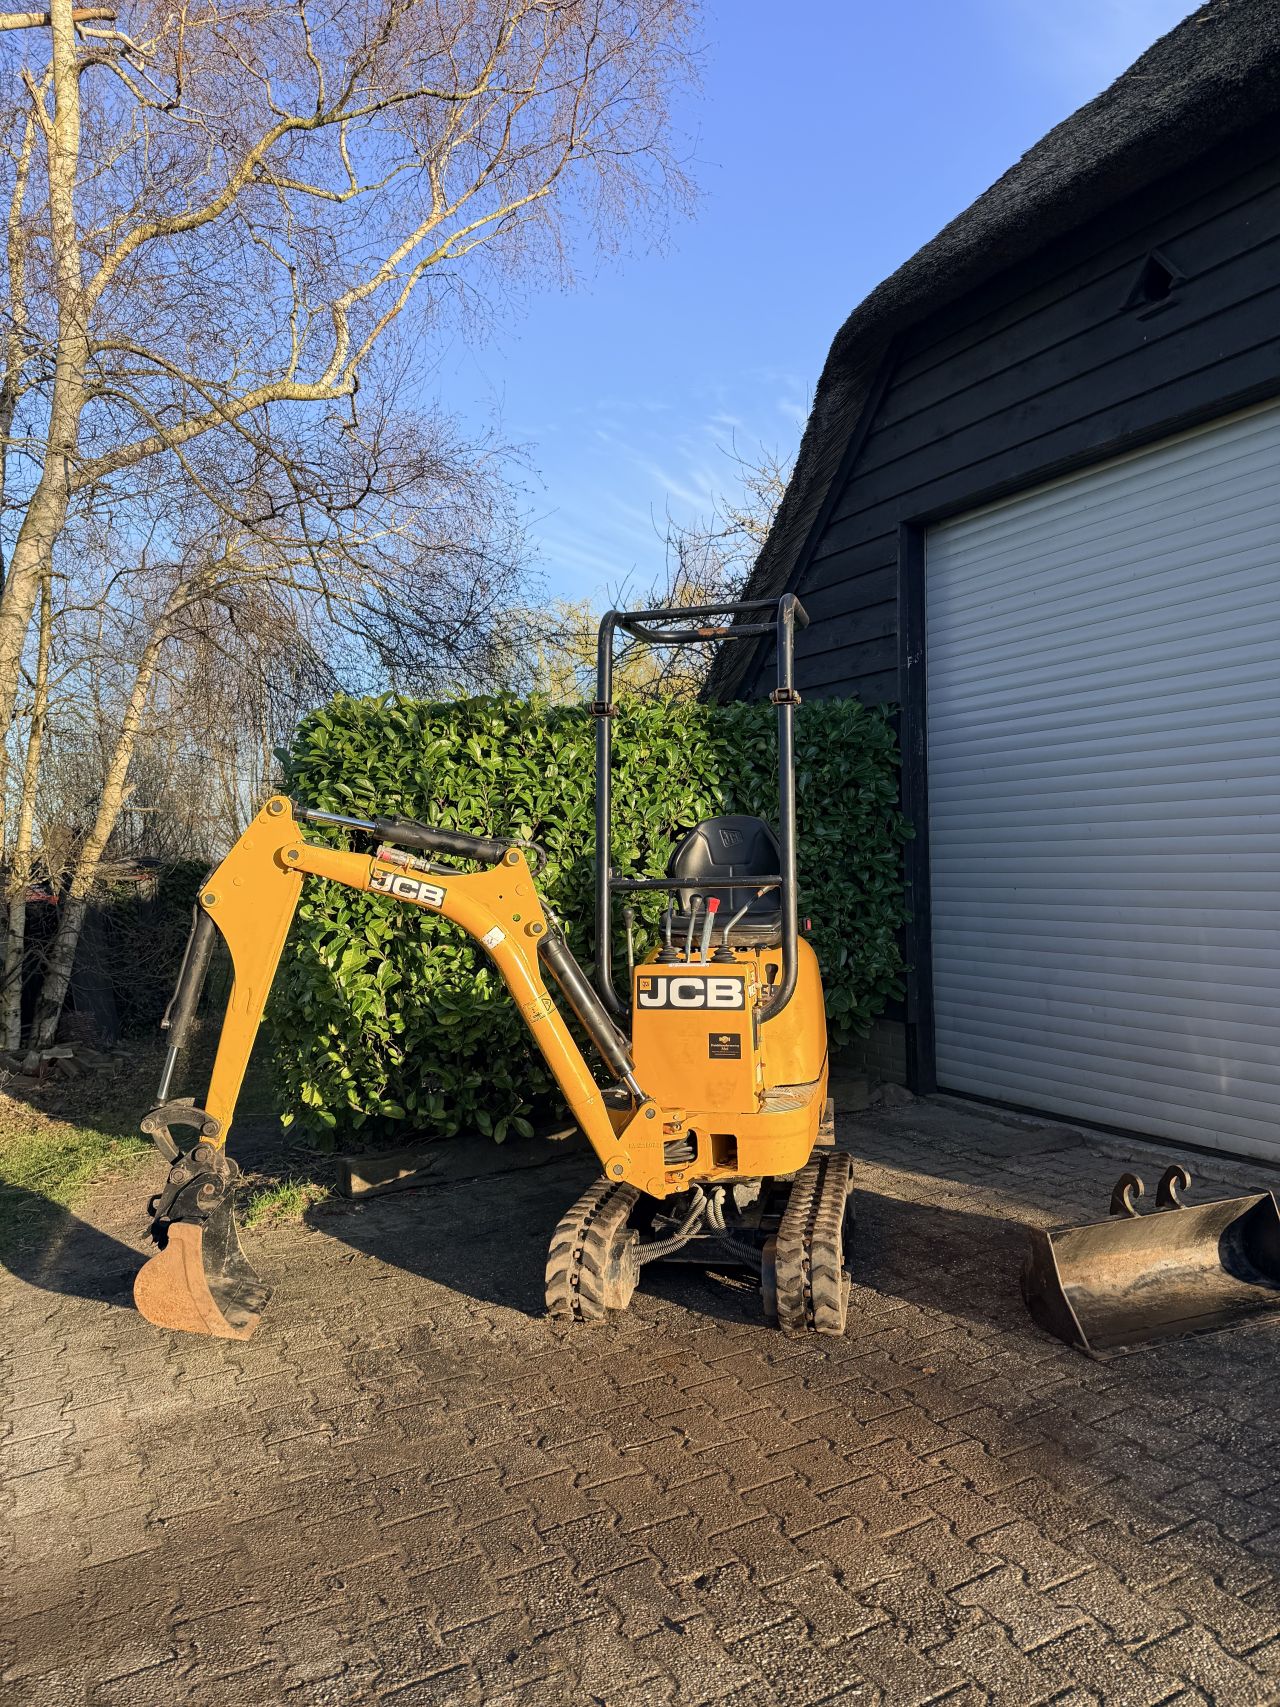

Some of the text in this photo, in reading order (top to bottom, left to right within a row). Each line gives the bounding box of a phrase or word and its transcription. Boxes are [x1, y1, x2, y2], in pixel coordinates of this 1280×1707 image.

[723, 831, 743, 846] JCB
[370, 872, 444, 907] JCB
[639, 977, 743, 1008] JCB
